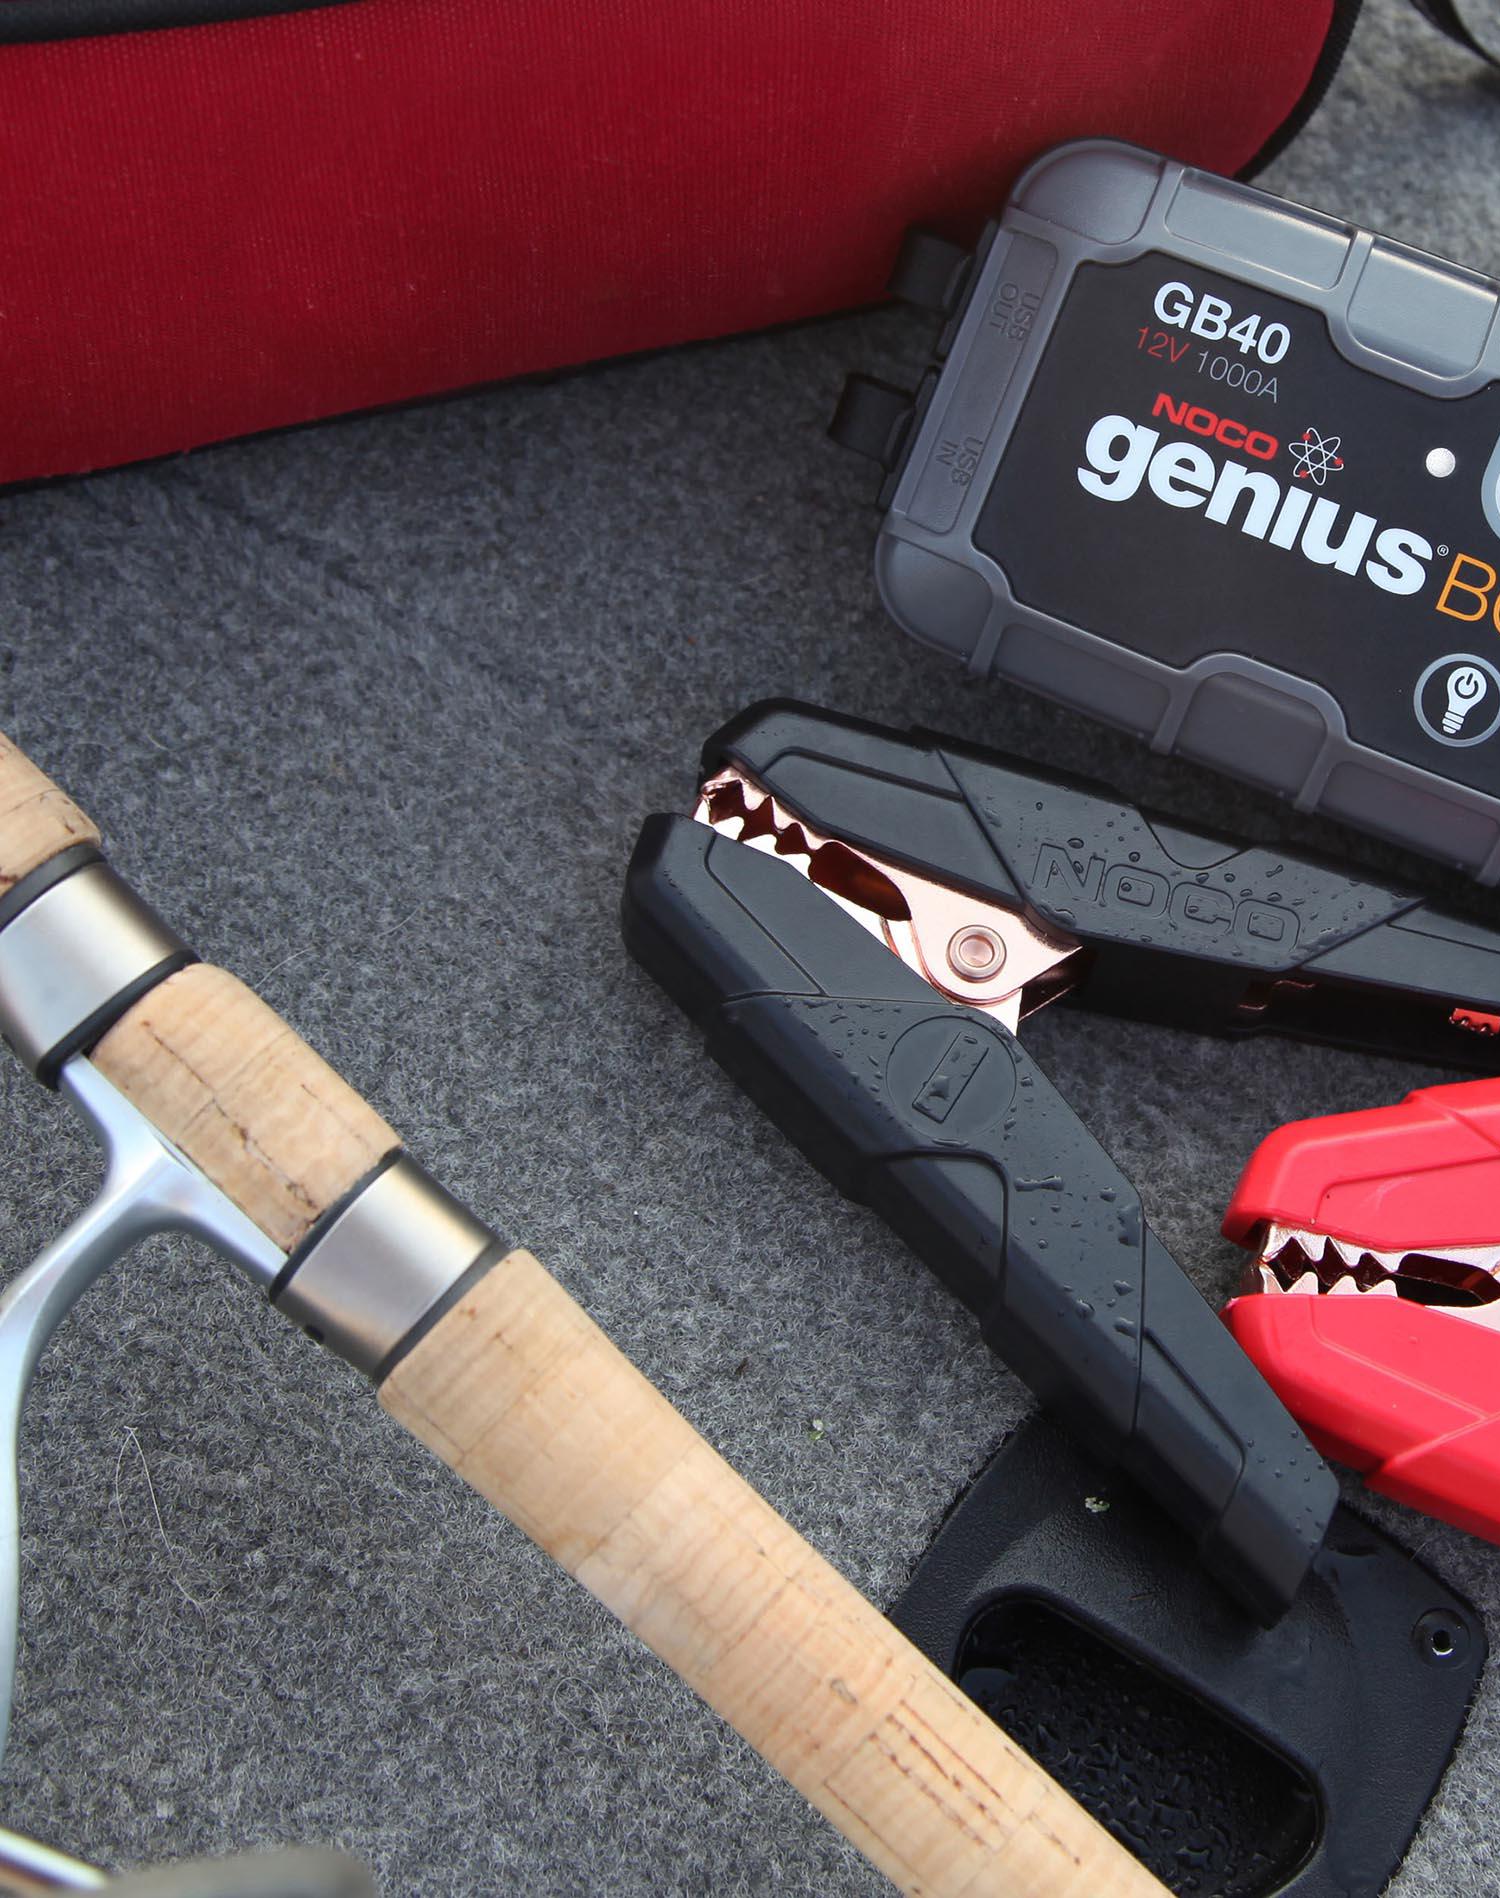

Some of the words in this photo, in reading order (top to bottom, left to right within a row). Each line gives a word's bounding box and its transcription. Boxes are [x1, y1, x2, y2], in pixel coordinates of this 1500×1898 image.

[990, 282, 1019, 334] OUT
[1007, 292, 1041, 341] USB
[1153, 281, 1291, 365] GB40
[1137, 326, 1190, 363] 12V
[1197, 350, 1279, 404] 1000A
[935, 439, 959, 467] IN
[1151, 392, 1279, 461] NOCO
[951, 435, 984, 487] USB
[1031, 842, 1301, 952] NOCO
